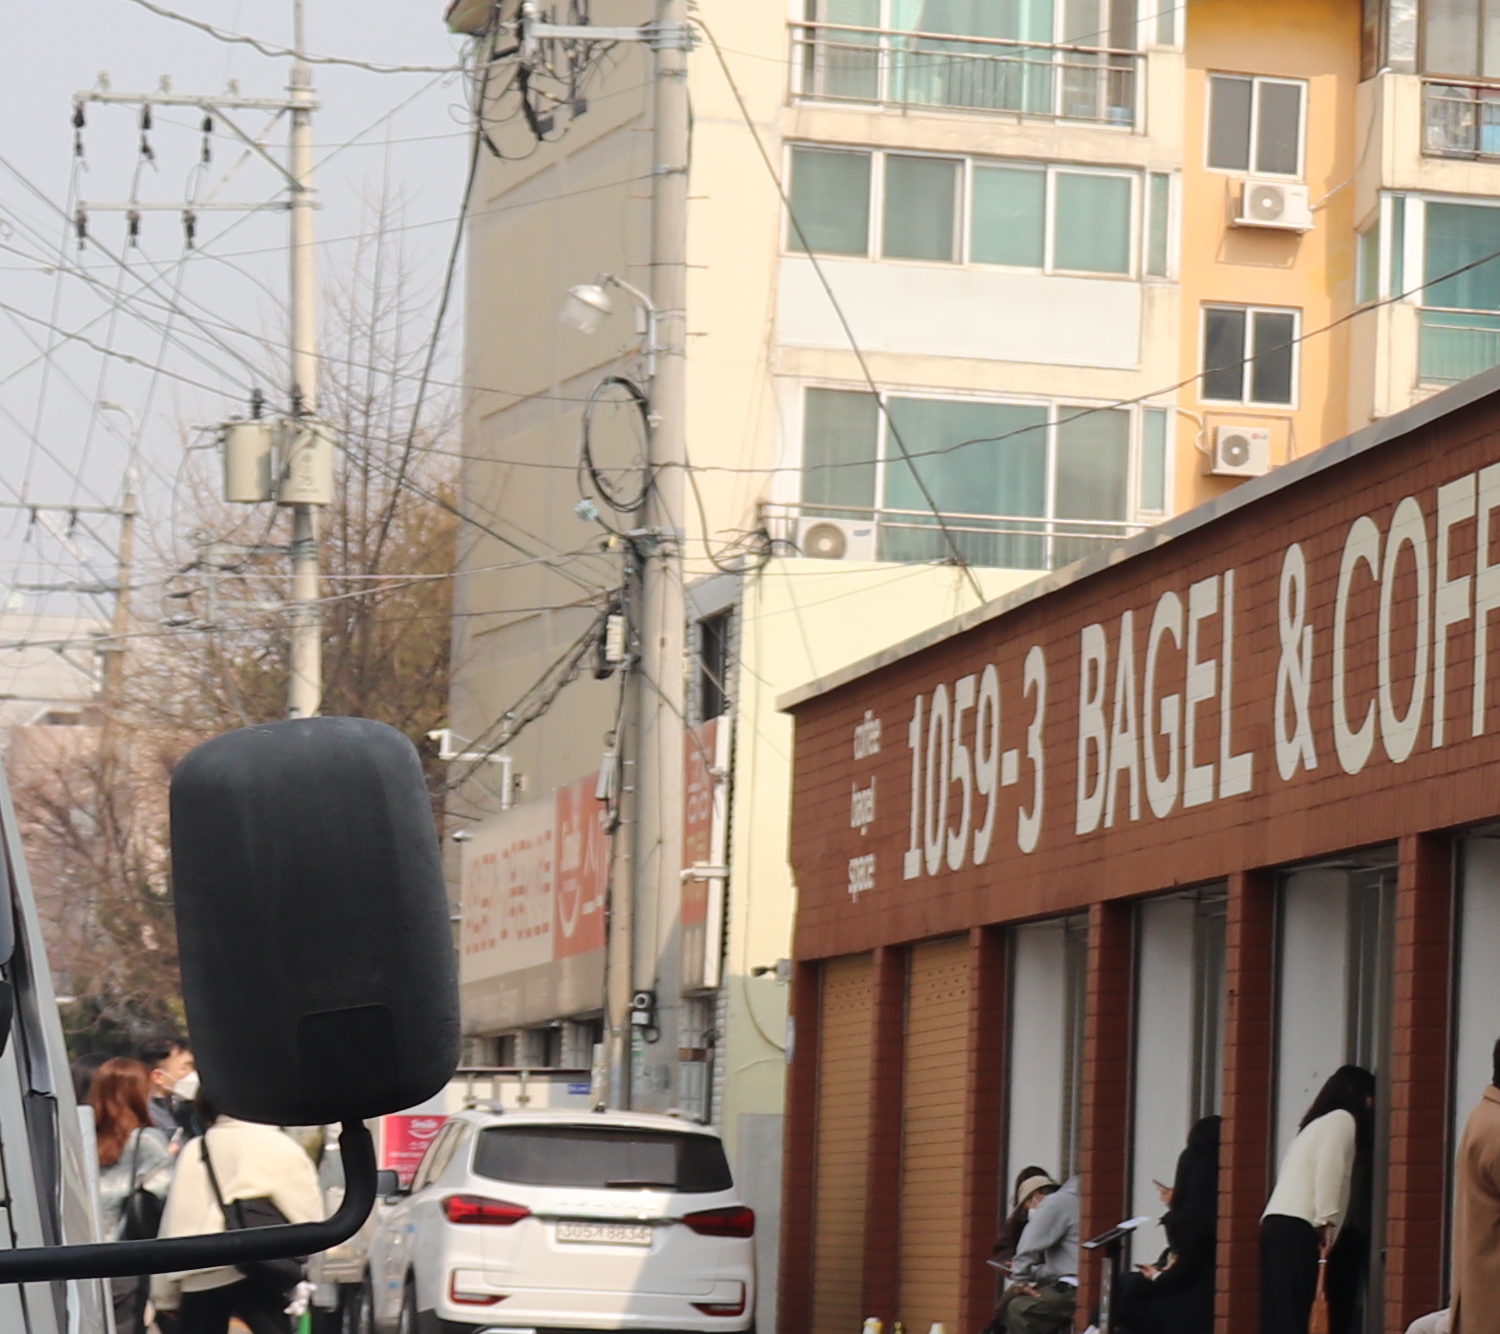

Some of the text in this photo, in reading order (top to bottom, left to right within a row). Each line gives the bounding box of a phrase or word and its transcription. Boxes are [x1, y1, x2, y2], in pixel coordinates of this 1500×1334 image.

[851, 775, 876, 836] bagel
[904, 645, 1047, 880] 1059-3
[1076, 569, 1253, 835] BAGEL
[1274, 543, 1316, 782] &
